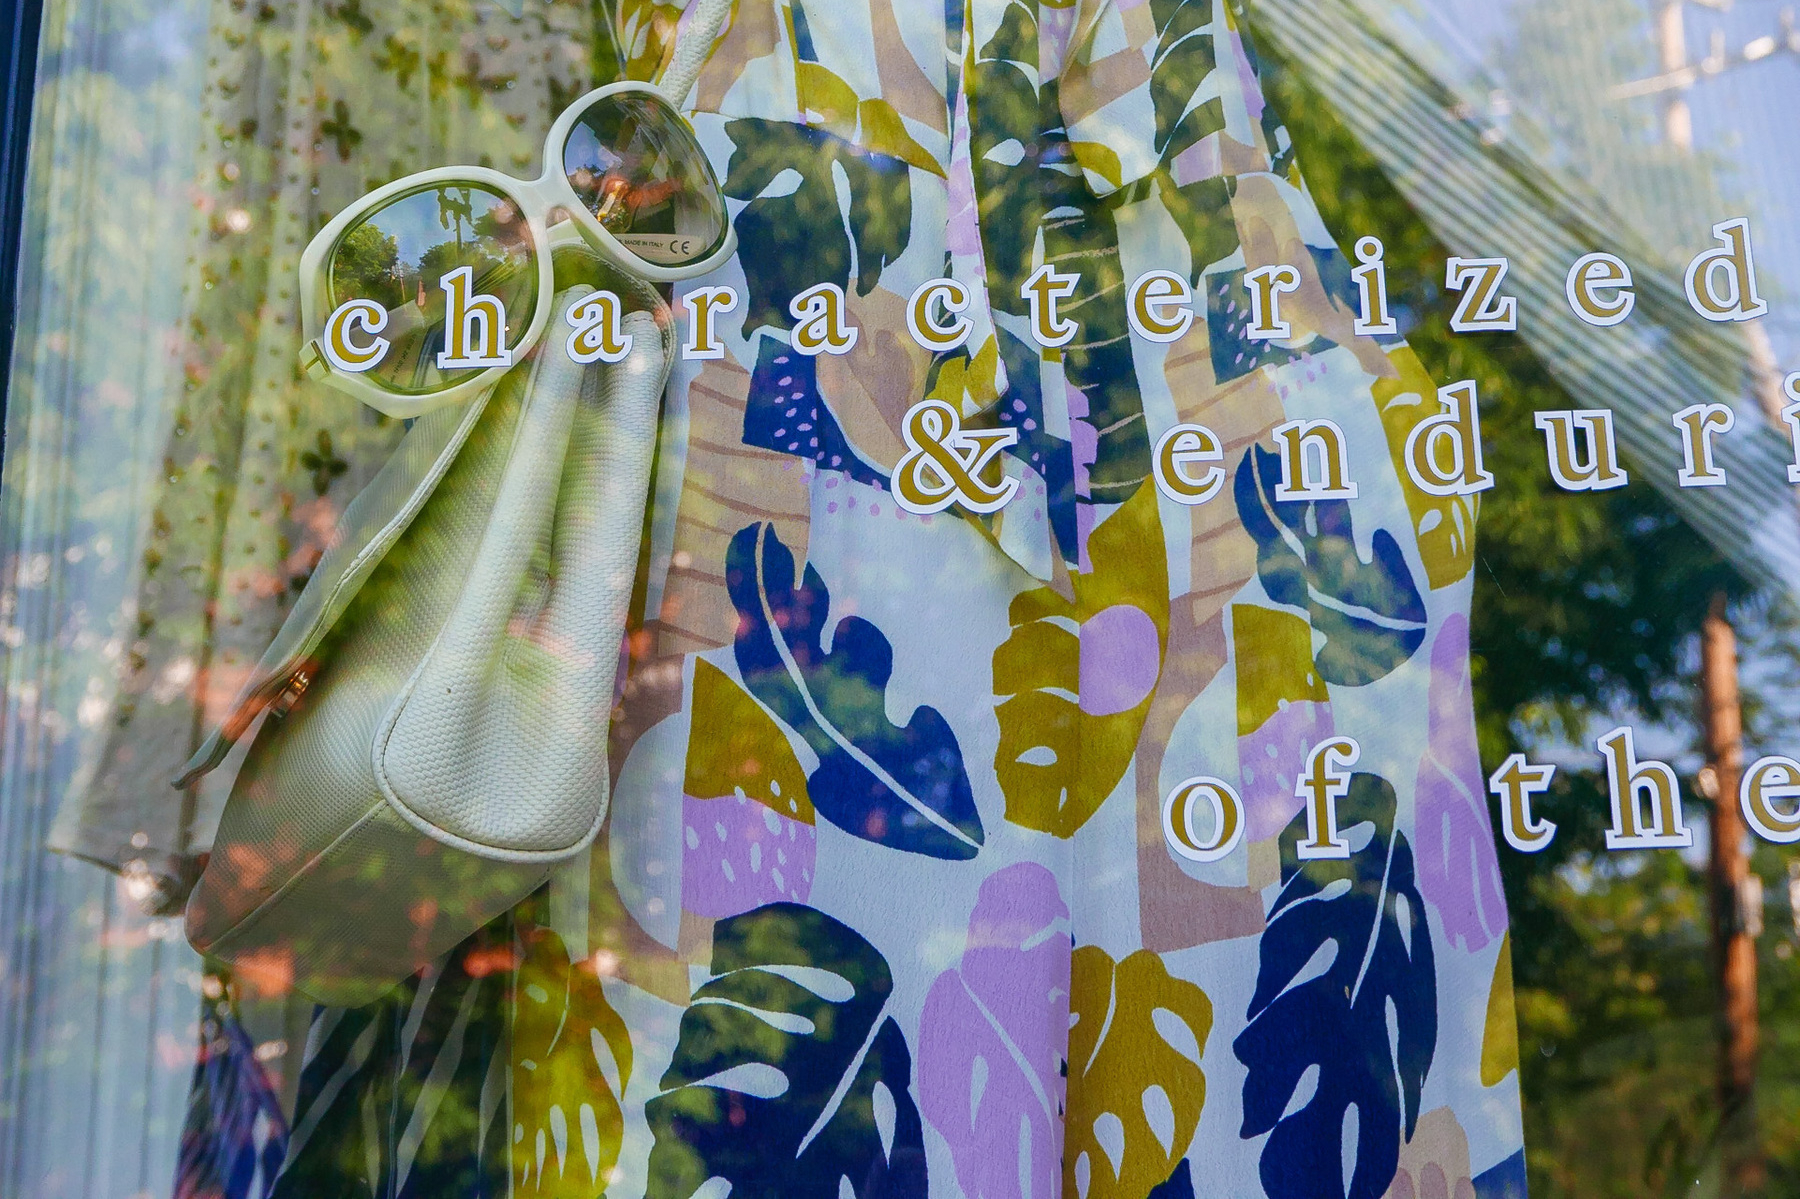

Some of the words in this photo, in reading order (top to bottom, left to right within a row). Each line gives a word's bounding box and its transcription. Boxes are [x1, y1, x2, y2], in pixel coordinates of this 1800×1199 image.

[324, 216, 1768, 373] characterized
[649, 240, 664, 248] ITALY
[890, 399, 1022, 516] &
[1161, 735, 1361, 863] of
[1489, 726, 1800, 853] the
